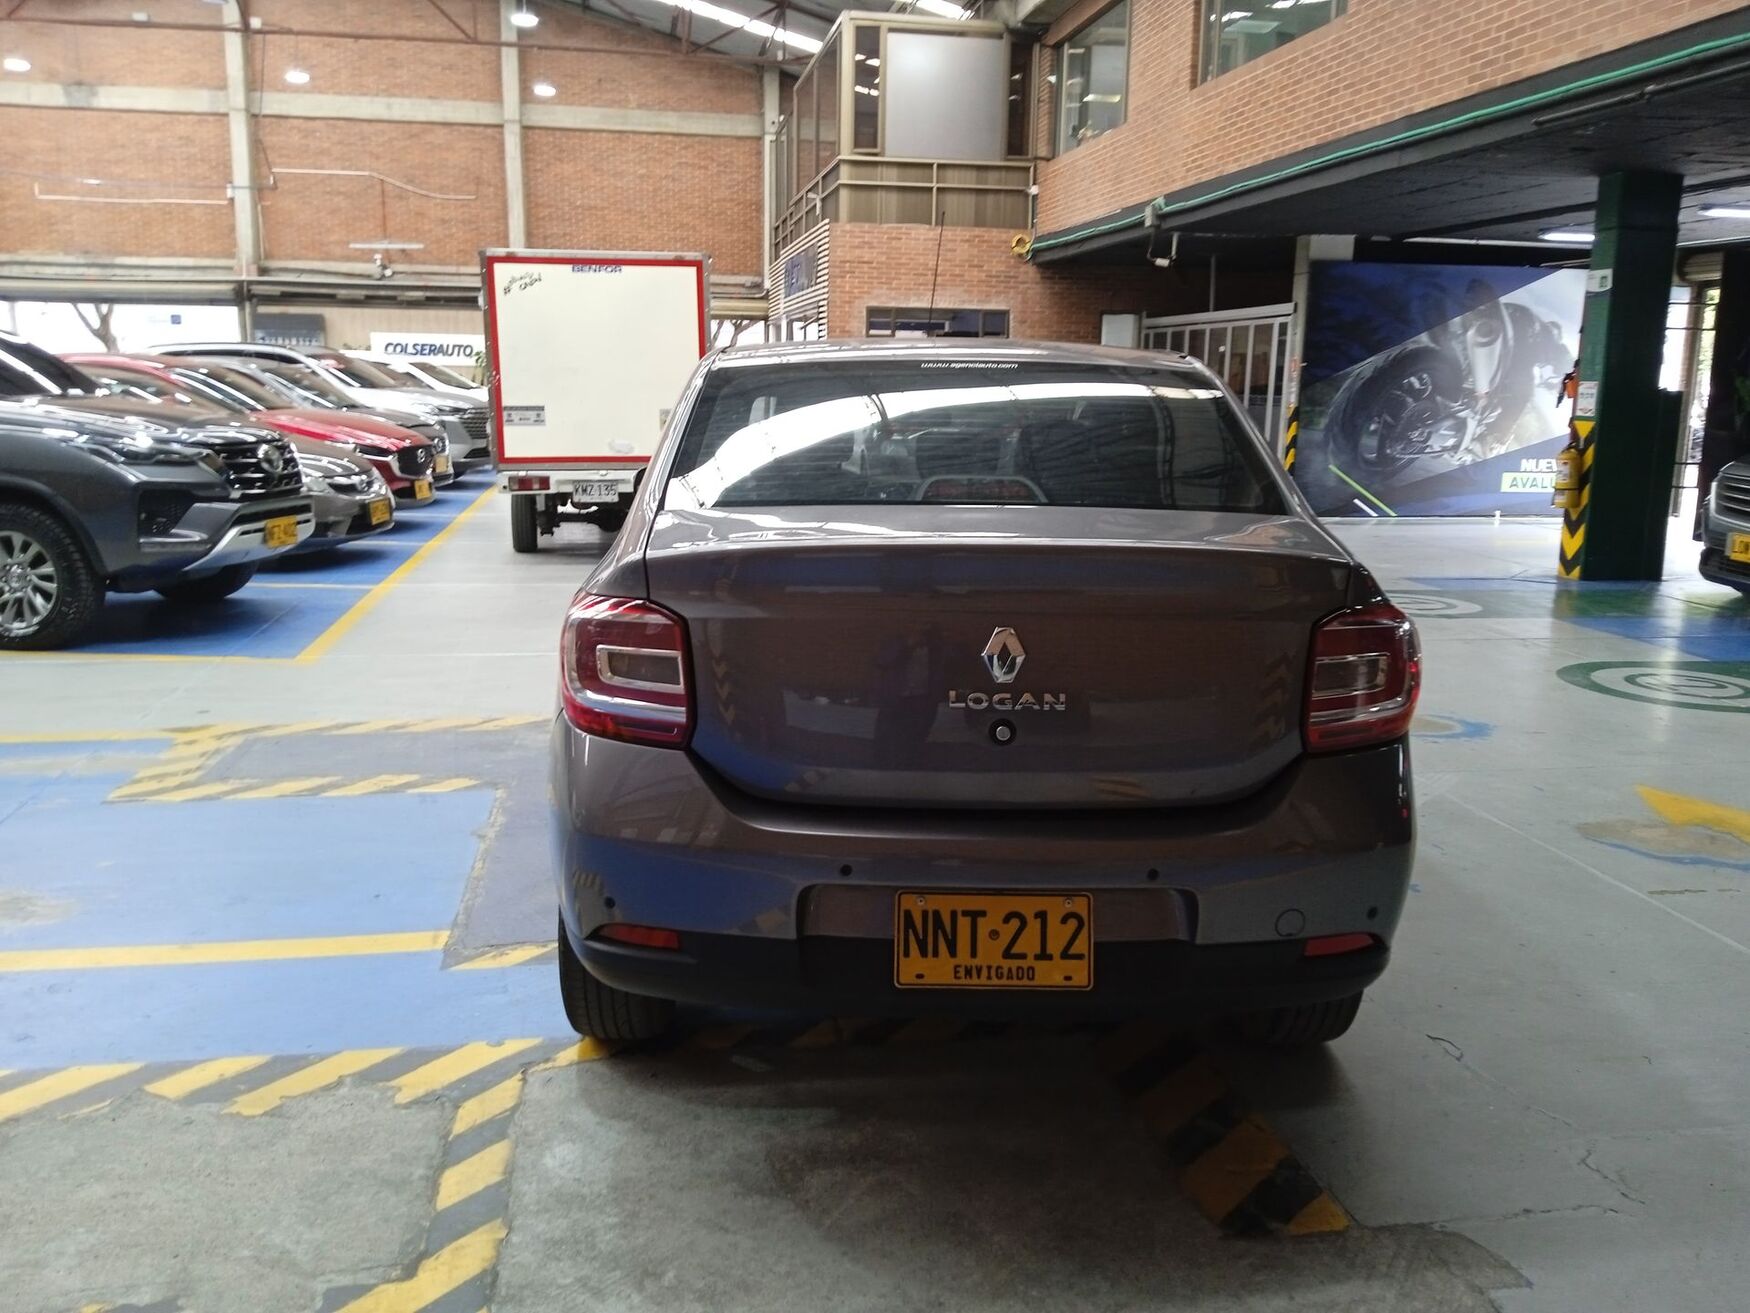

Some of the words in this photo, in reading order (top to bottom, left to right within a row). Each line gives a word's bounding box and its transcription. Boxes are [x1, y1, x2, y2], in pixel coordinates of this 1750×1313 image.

[384, 342, 474, 358] COLSERAUTO
[948, 690, 1066, 711] LOGAN
[953, 964, 1036, 982] ENVIGADO
